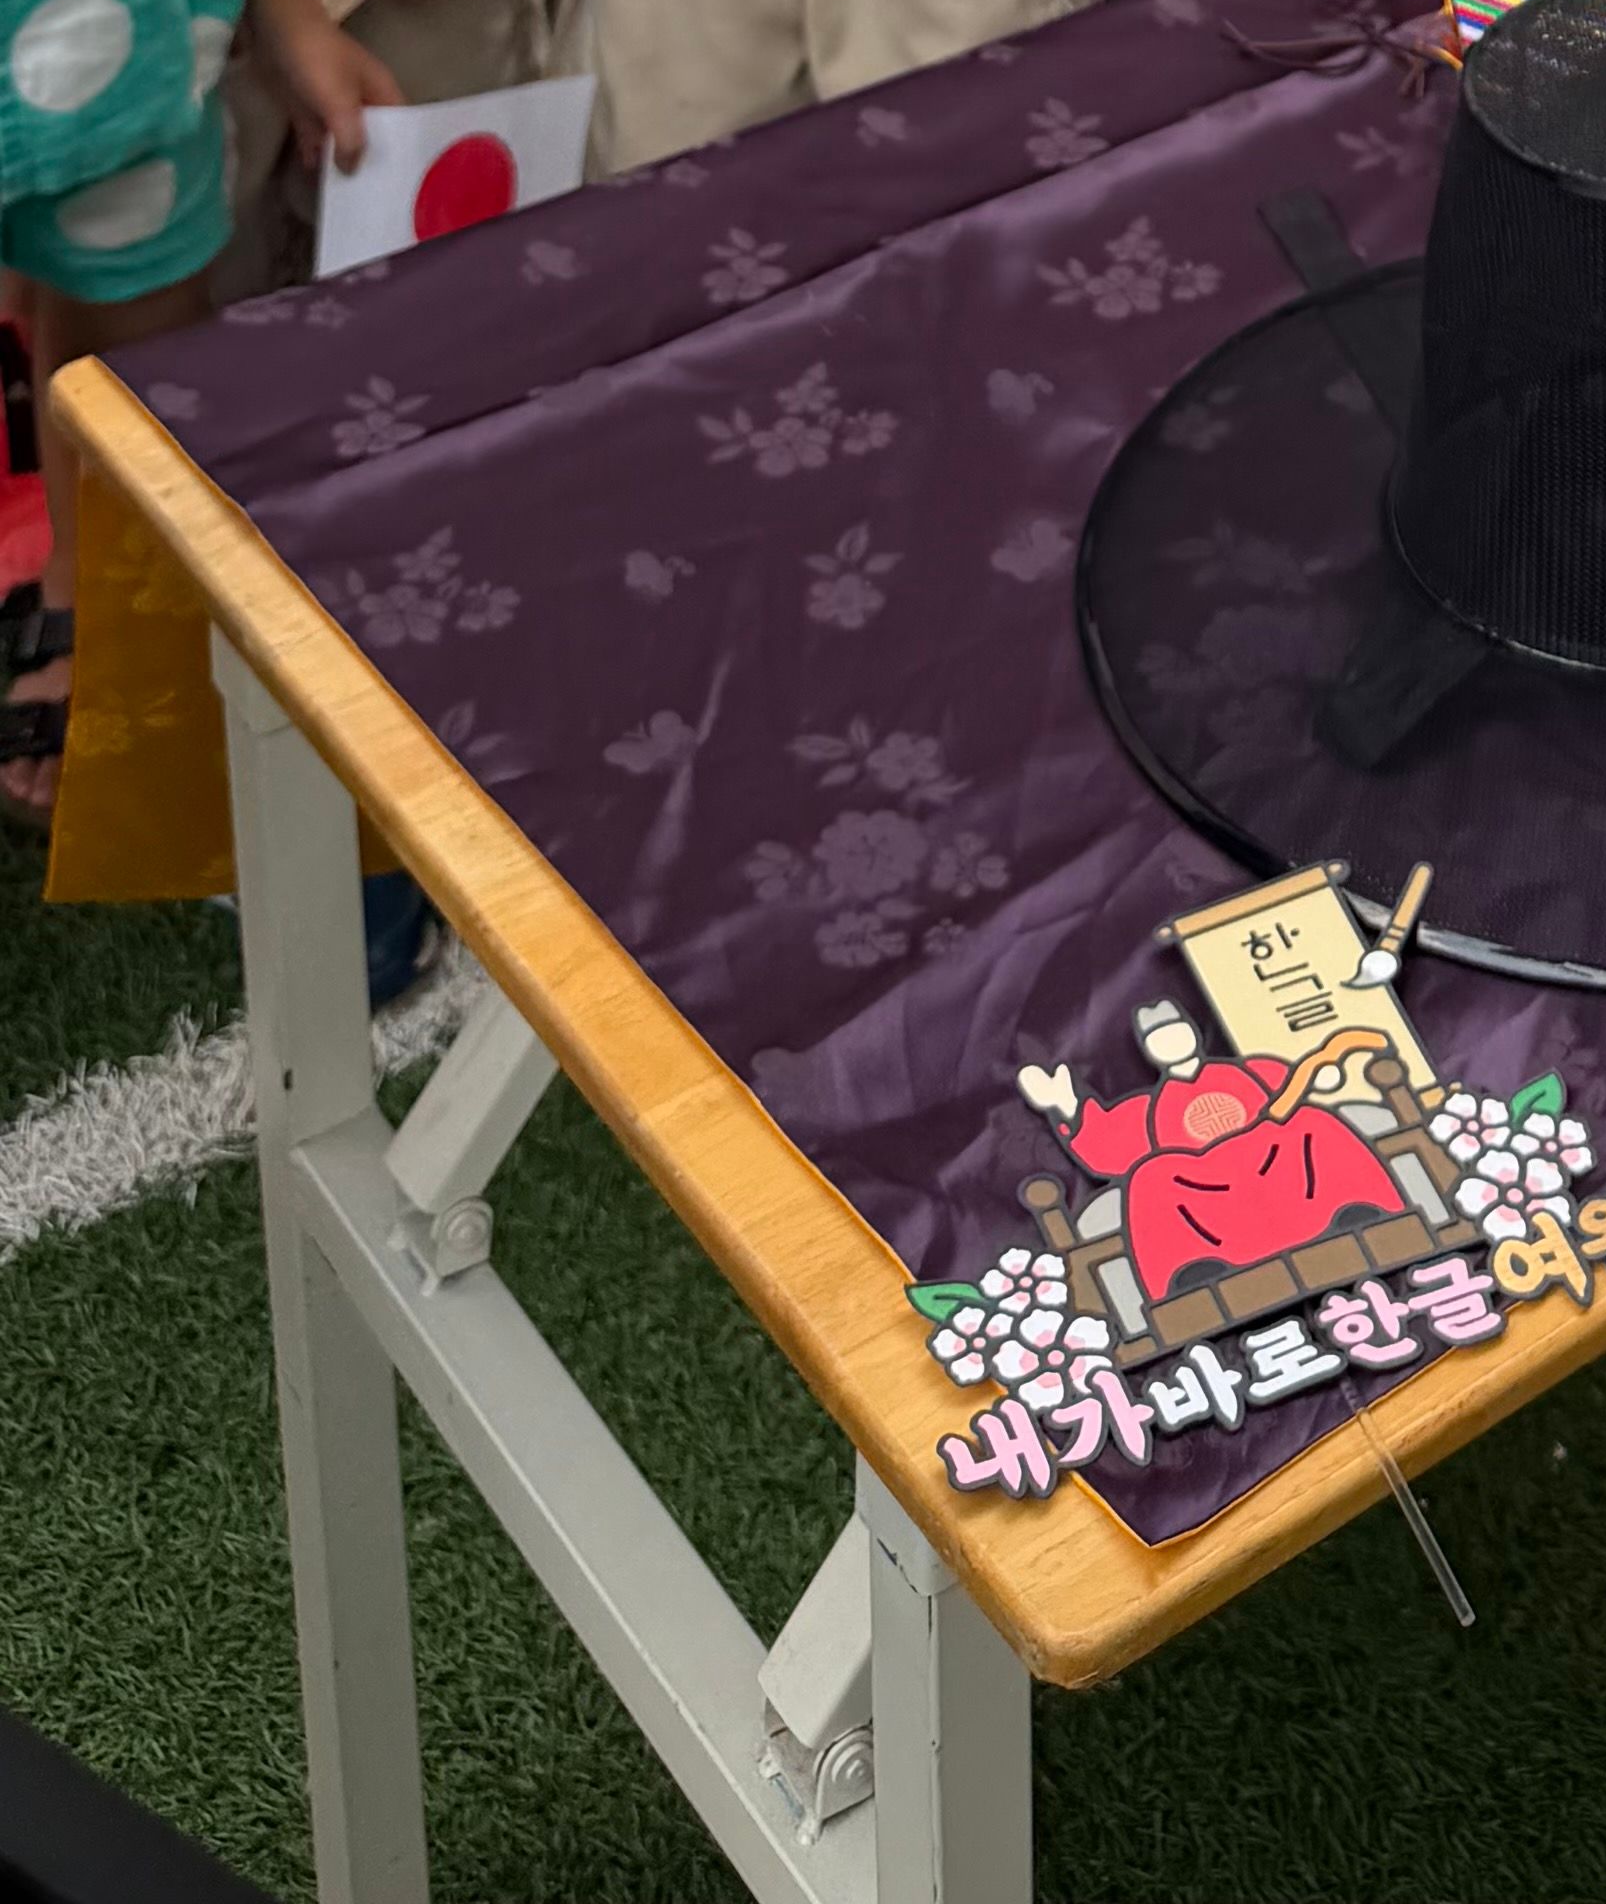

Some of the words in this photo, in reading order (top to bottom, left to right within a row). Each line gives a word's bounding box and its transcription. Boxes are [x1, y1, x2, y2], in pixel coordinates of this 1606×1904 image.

[1241, 922, 1338, 1033] 한글
[942, 1369, 1155, 1492] 내가
[1150, 1318, 1341, 1428] 바로
[1318, 1256, 1503, 1366] 한글
